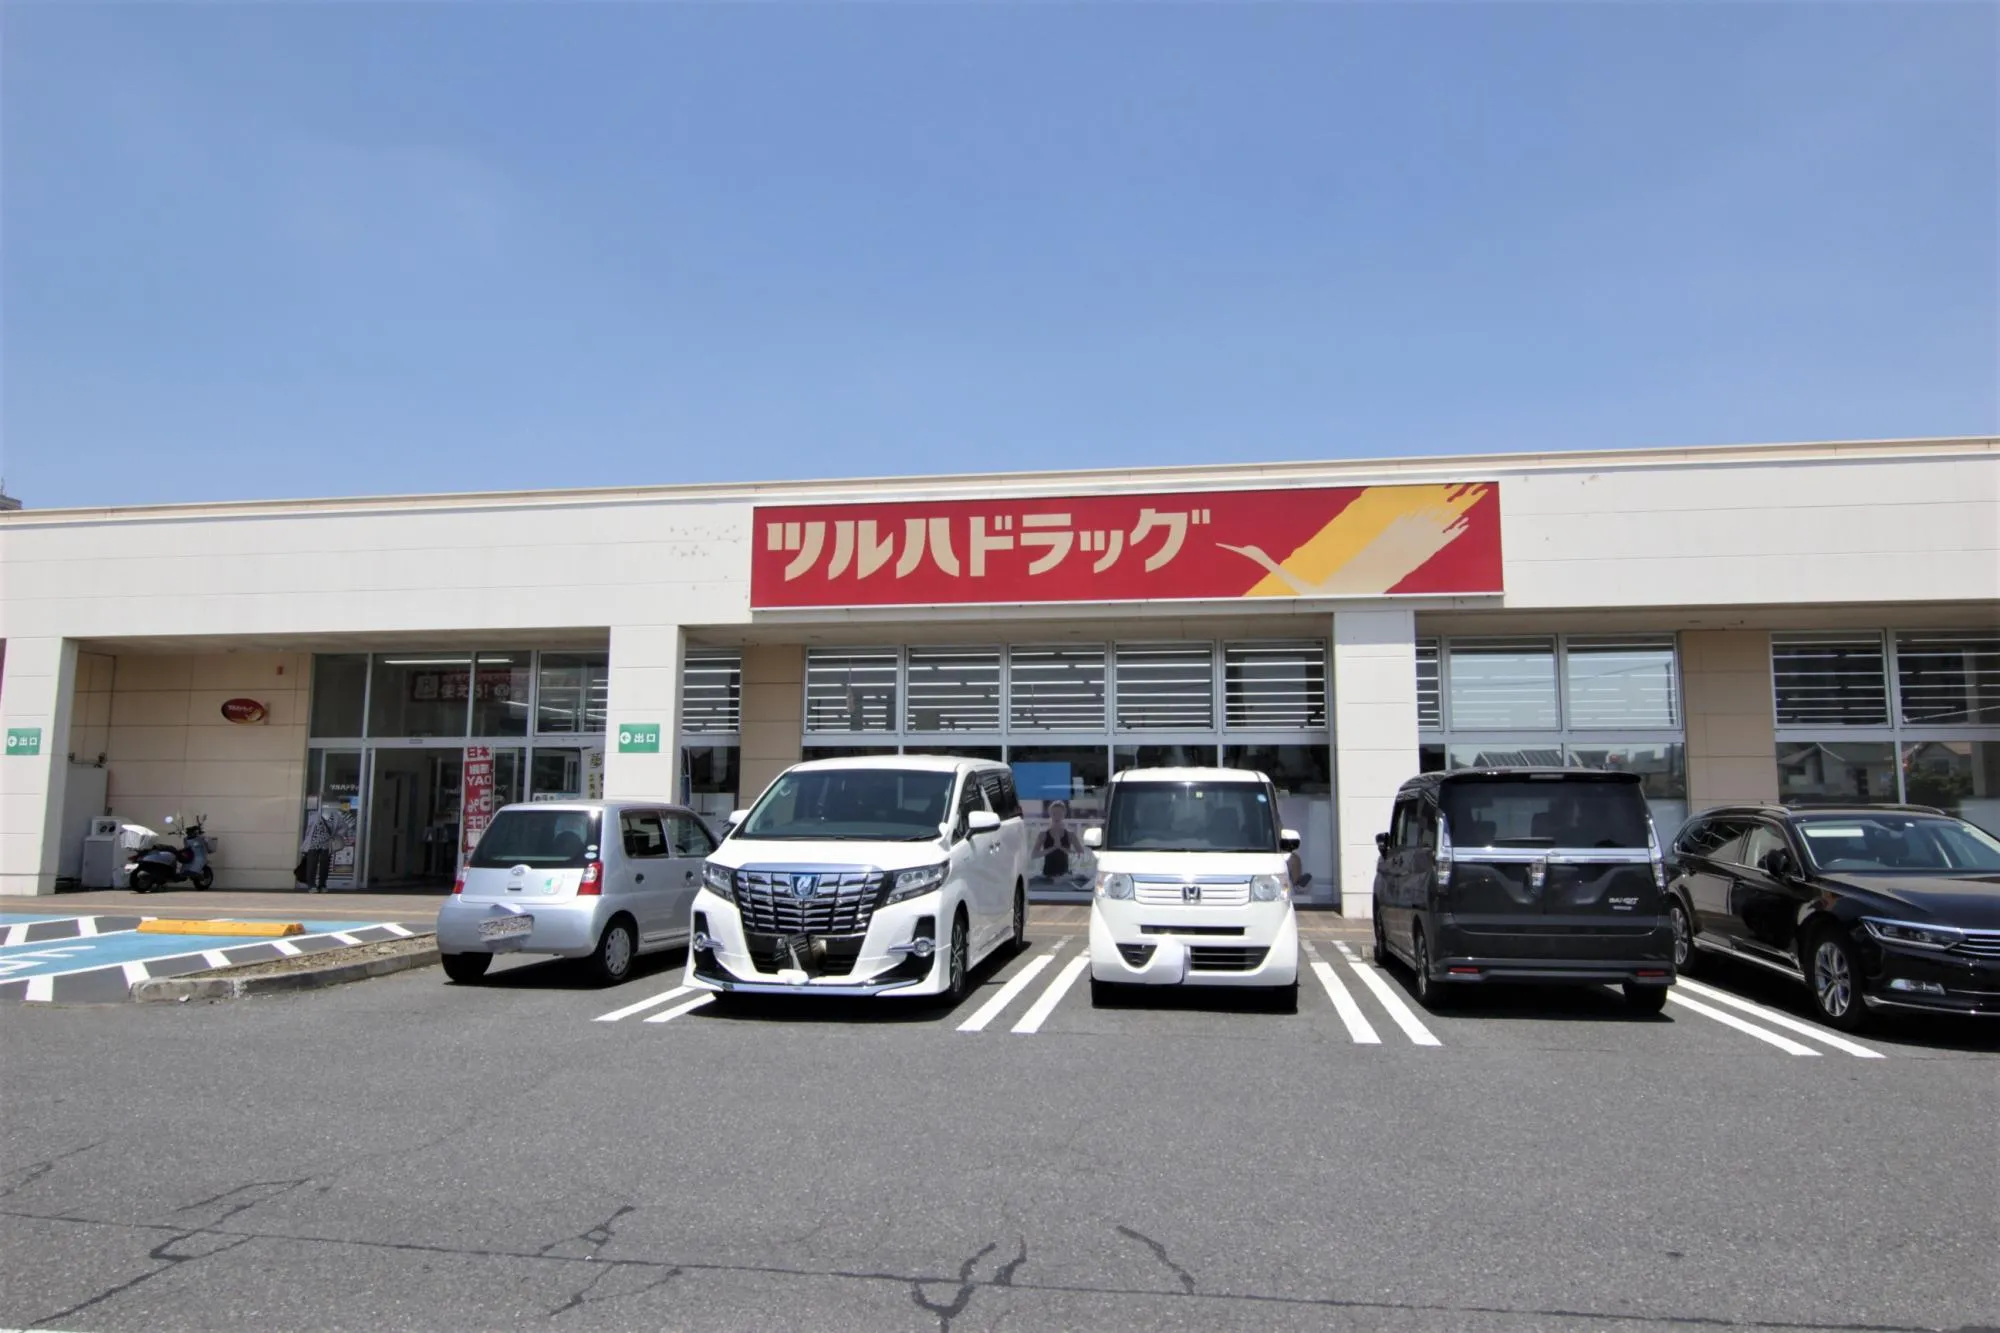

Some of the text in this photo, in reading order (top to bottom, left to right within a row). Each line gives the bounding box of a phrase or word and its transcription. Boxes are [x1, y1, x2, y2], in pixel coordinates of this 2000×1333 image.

[766, 507, 1211, 583] ツルハドラッグ
[18, 735, 38, 747] 出口
[633, 732, 656, 744] 出口
